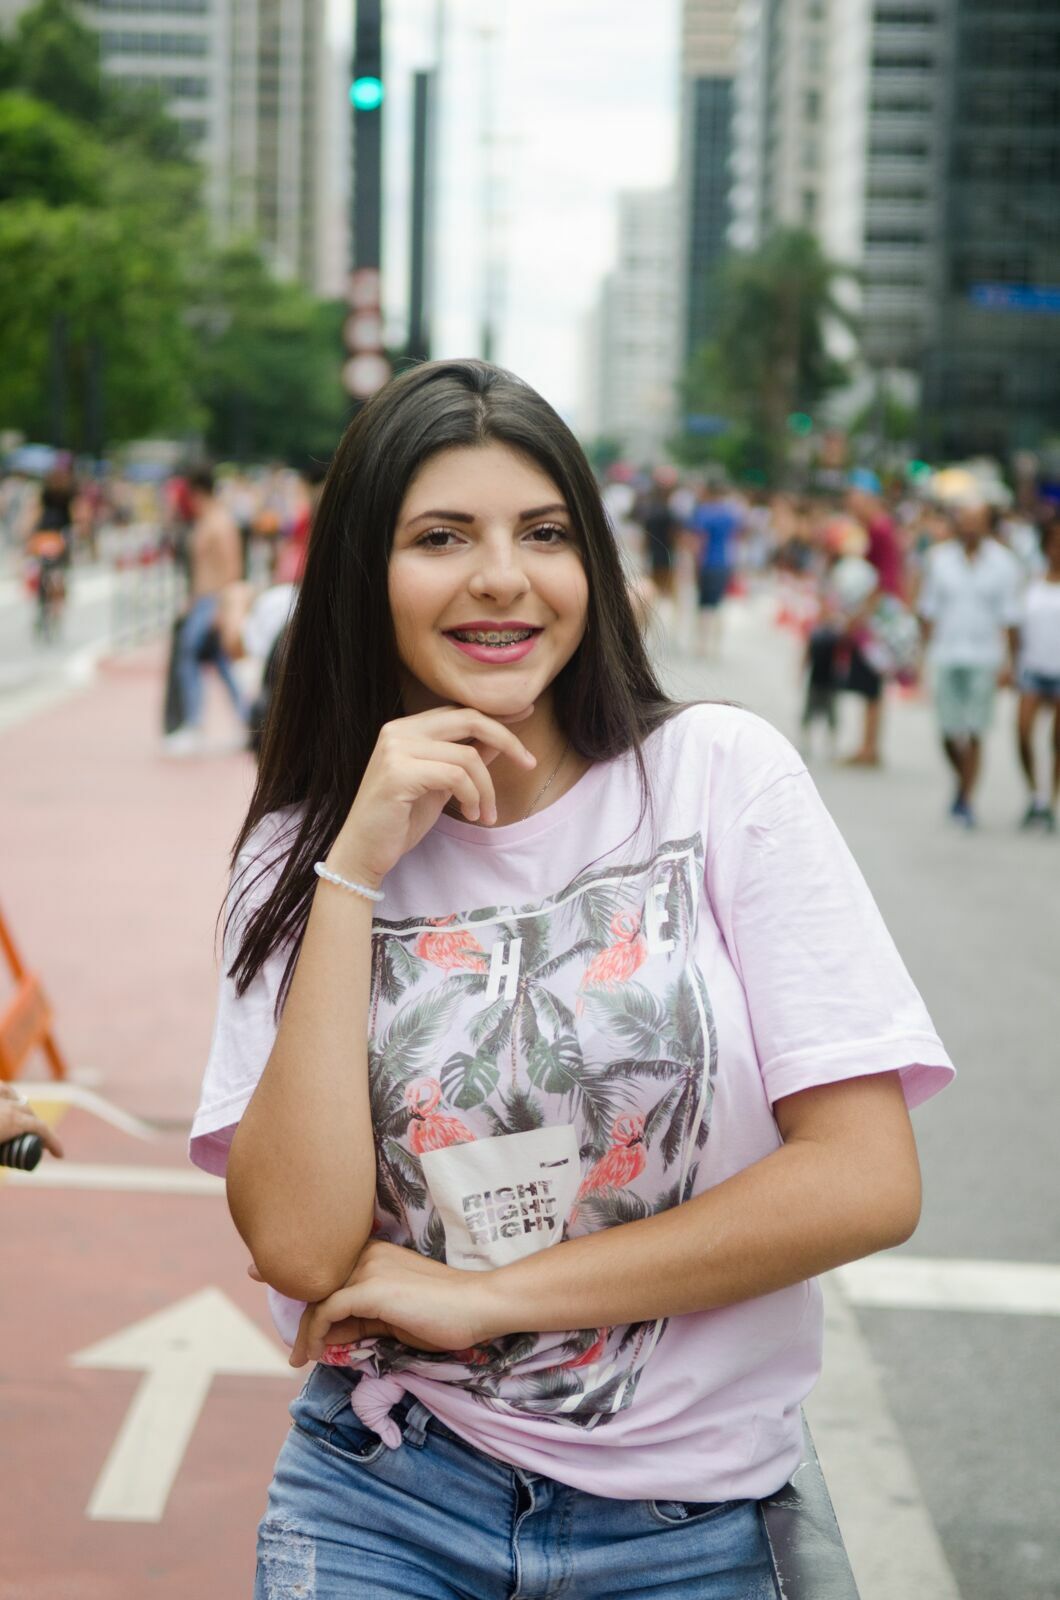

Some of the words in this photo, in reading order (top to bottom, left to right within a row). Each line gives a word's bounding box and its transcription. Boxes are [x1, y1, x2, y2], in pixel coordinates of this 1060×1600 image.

[485, 937, 523, 1001] H
[645, 882, 675, 955] E
[462, 1180, 552, 1212] RIGHT
[465, 1198, 556, 1230] RIGHT
[470, 1214, 556, 1245] RIGHT
